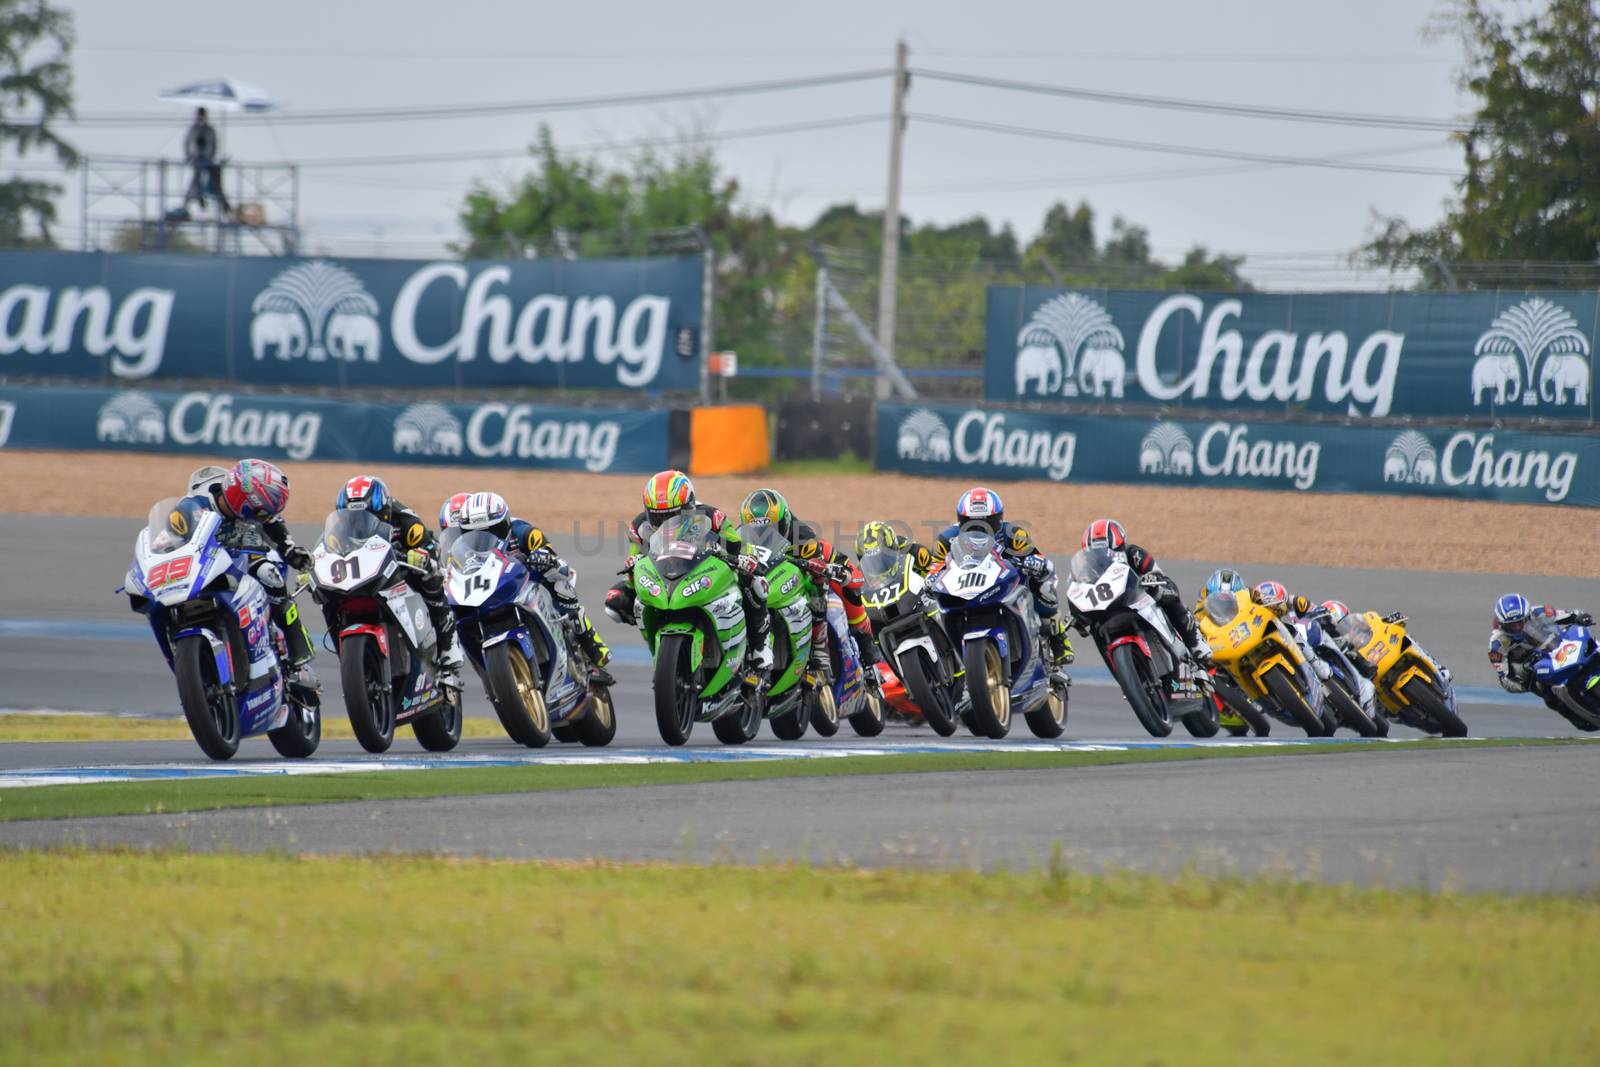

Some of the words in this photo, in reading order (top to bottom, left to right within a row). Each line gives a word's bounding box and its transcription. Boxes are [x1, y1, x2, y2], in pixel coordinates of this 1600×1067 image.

[0, 283, 175, 377] ang
[391, 262, 671, 387] Chang
[1136, 294, 1405, 418] Chang
[169, 392, 321, 459] Chang
[466, 403, 620, 472] Chang
[952, 409, 1077, 481] Chang
[1196, 421, 1321, 491] Chang
[1440, 431, 1578, 503] Chang
[146, 555, 193, 590] 99
[330, 556, 360, 584] 91
[464, 574, 490, 601] 14
[682, 578, 701, 597] elf
[871, 583, 900, 609] 127
[957, 572, 986, 590] 500
[1085, 583, 1114, 608] 18
